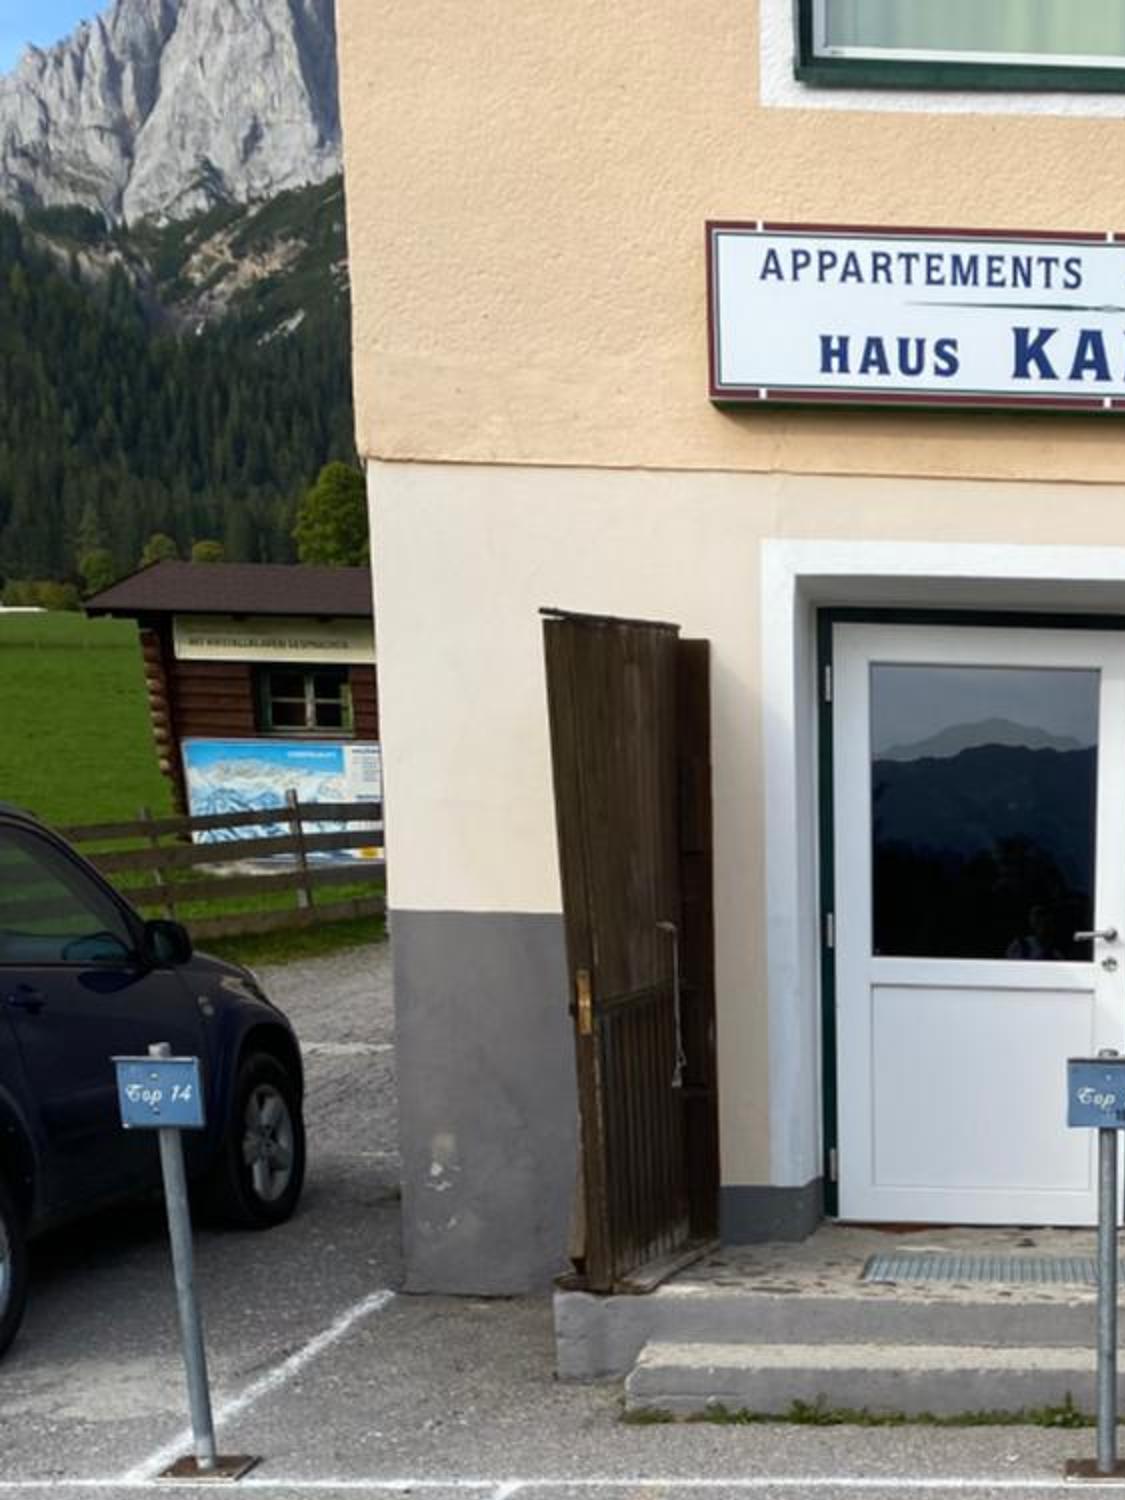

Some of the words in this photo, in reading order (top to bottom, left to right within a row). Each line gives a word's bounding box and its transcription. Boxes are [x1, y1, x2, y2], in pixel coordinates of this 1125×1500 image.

[759, 248, 1083, 290] APPARTEMENTS
[819, 334, 960, 378] HAUS
[125, 1083, 162, 1107] Top
[172, 1084, 192, 1103] 14
[1078, 1088, 1116, 1111] Top
